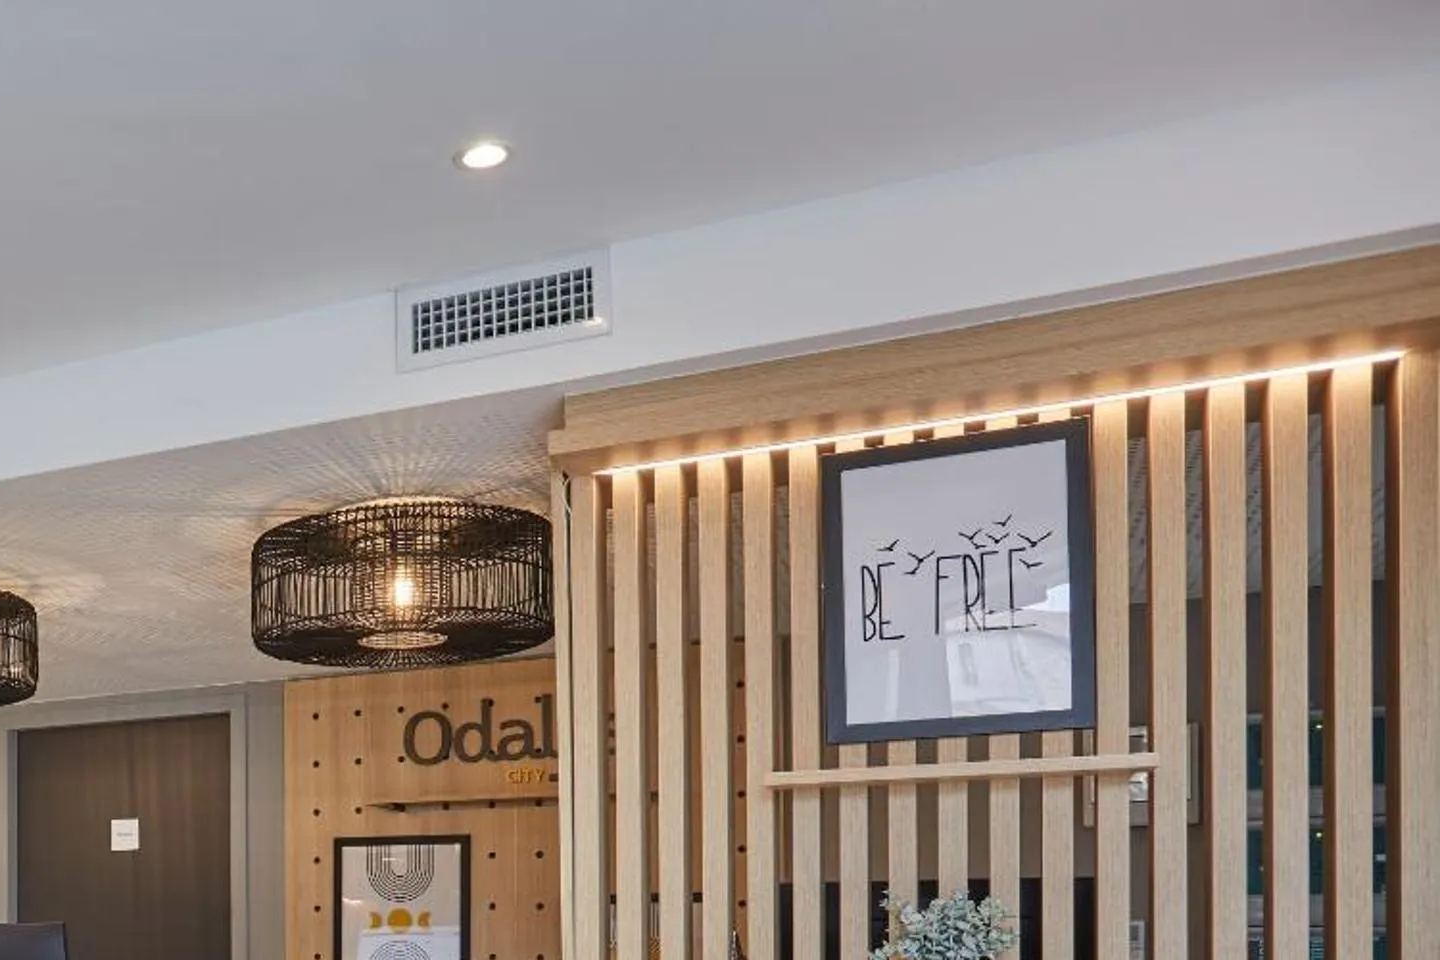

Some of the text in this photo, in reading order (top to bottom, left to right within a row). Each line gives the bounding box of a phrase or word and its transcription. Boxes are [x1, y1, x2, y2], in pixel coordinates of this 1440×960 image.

[861, 547, 1037, 642] BE FREE
[403, 693, 558, 768] Odal
[509, 767, 545, 784] CITY
